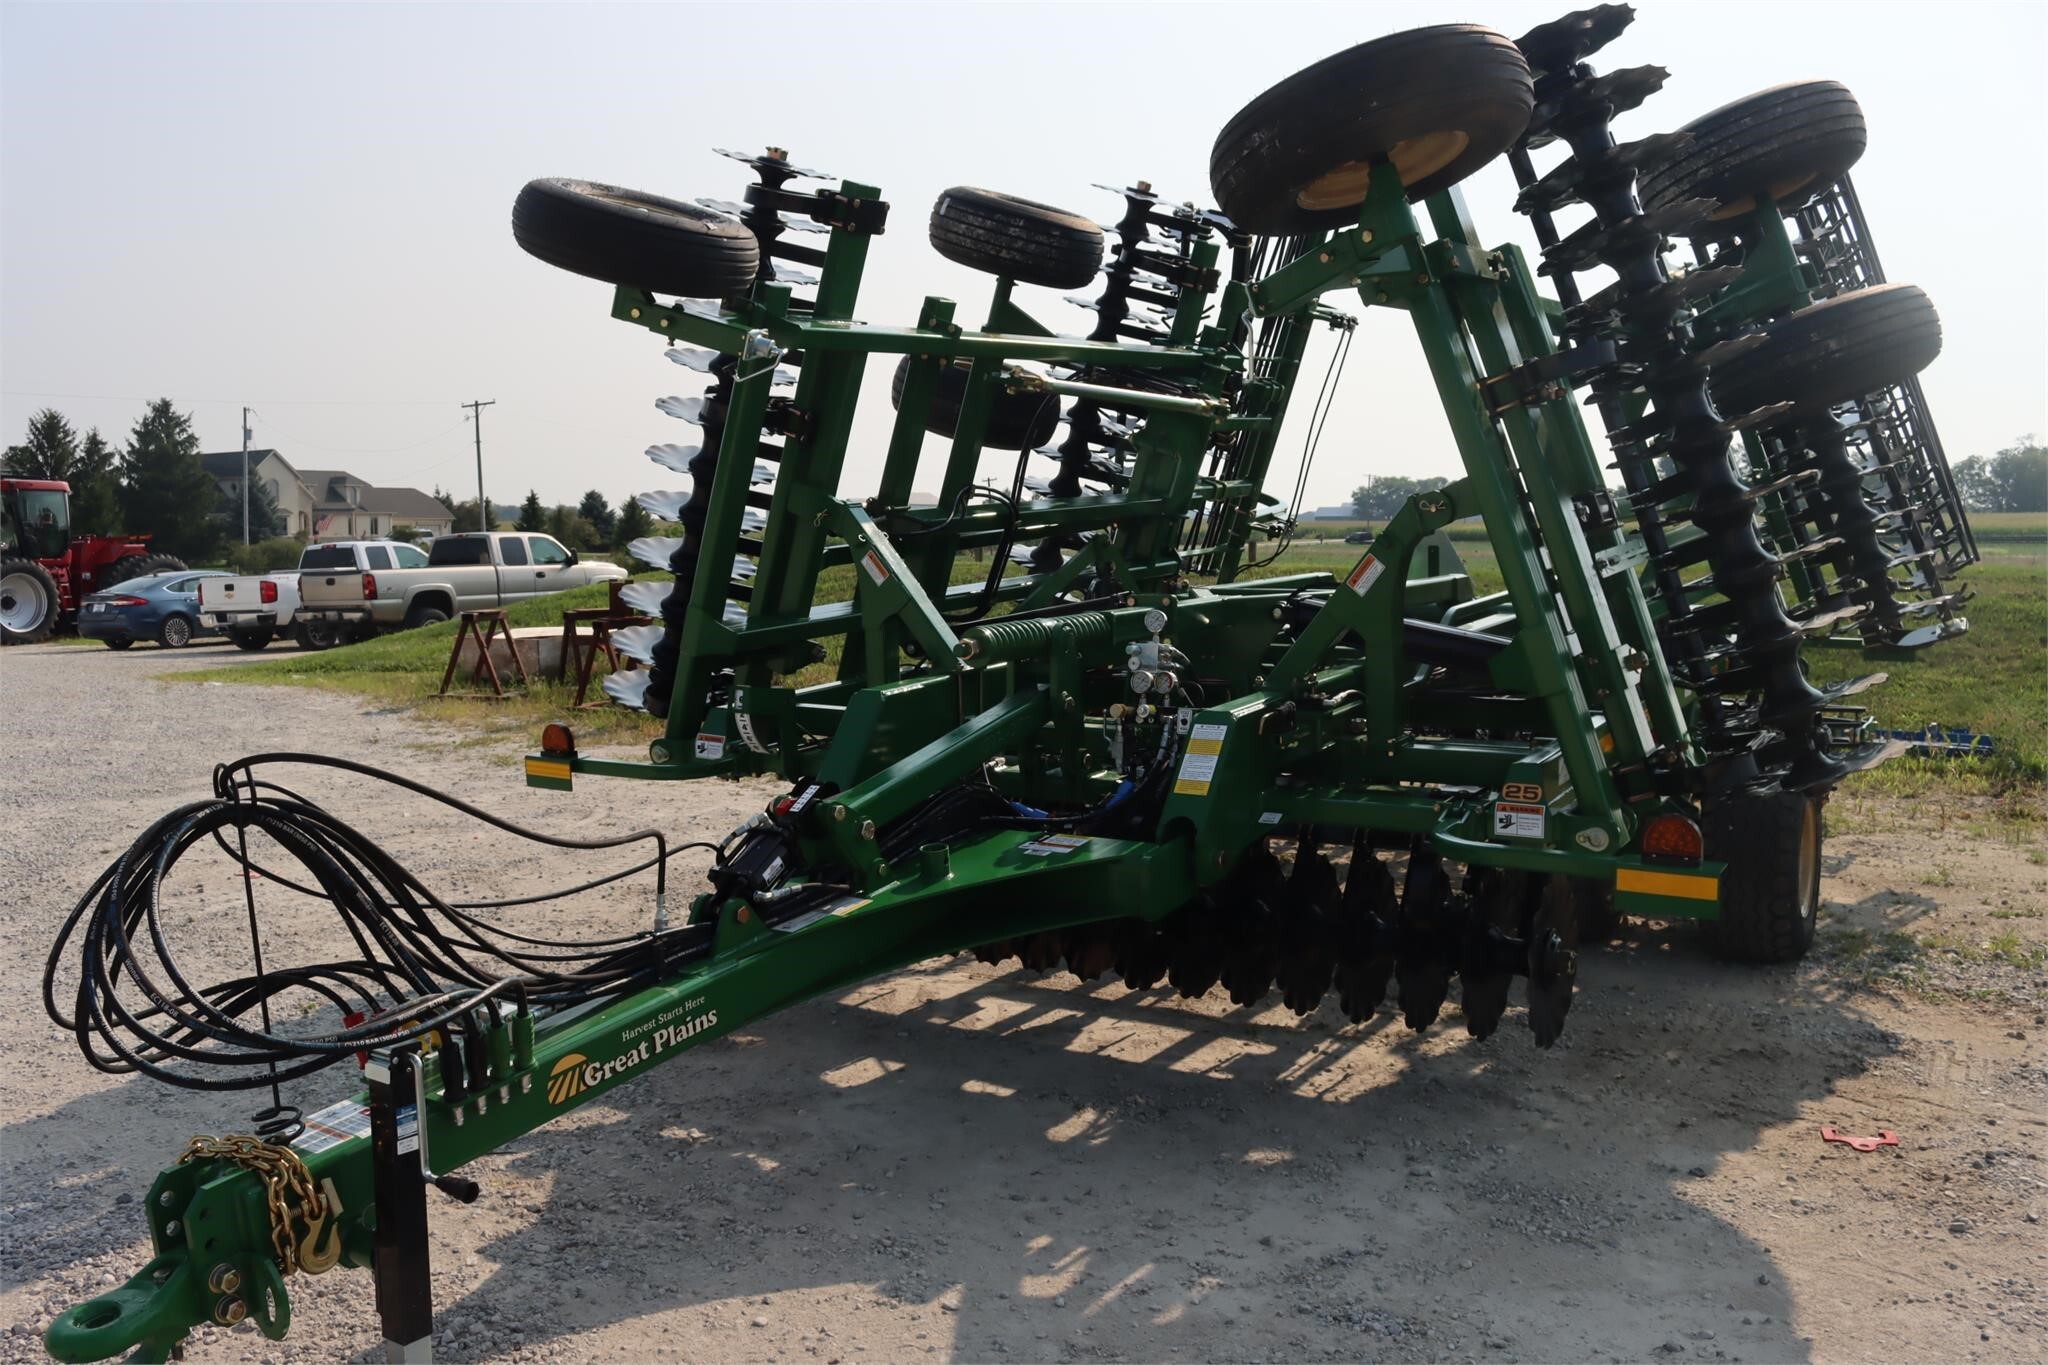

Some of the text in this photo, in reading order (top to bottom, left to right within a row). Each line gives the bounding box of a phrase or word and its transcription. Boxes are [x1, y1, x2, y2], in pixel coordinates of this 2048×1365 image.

[1505, 784, 1540, 801] 25
[621, 996, 706, 1042] Harvest Starts Here
[584, 1009, 718, 1087] Great Plains
